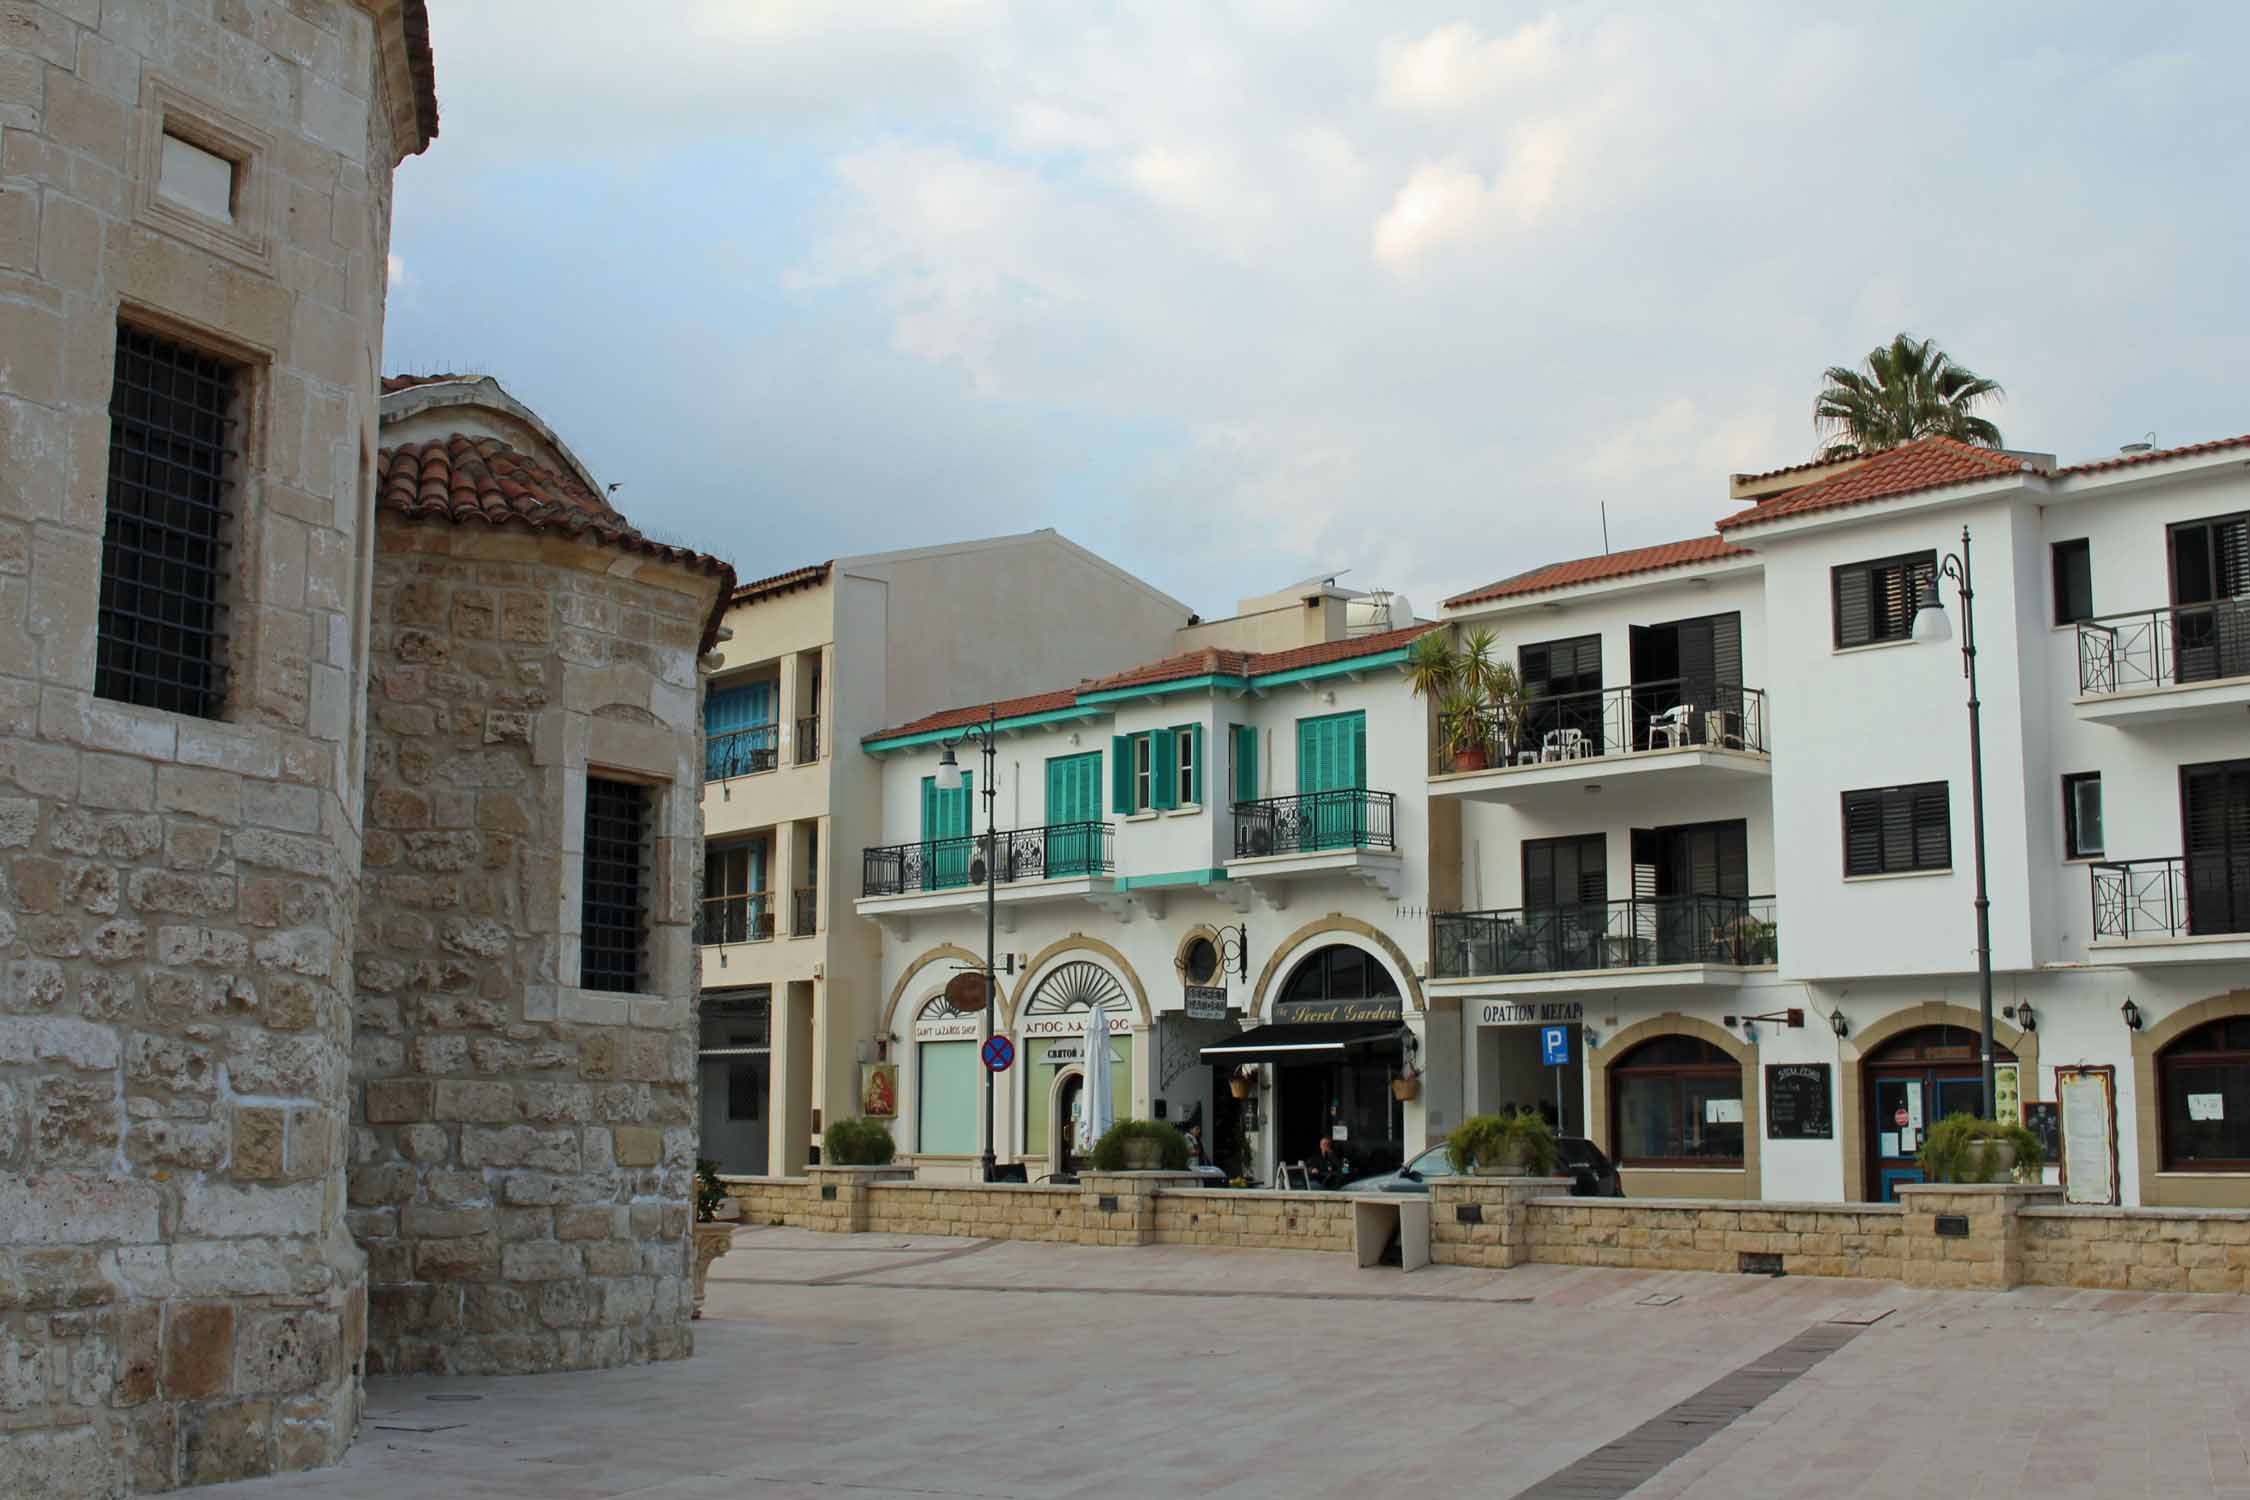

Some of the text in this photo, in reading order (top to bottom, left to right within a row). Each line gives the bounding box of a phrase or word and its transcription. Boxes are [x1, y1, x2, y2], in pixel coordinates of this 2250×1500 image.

[1291, 1006, 1340, 1022] Secret
[1344, 1004, 1397, 1021] Garden
[916, 1027, 934, 1037] SAINT
[961, 1024, 977, 1034] SHOP
[1547, 1030, 1562, 1054] P
